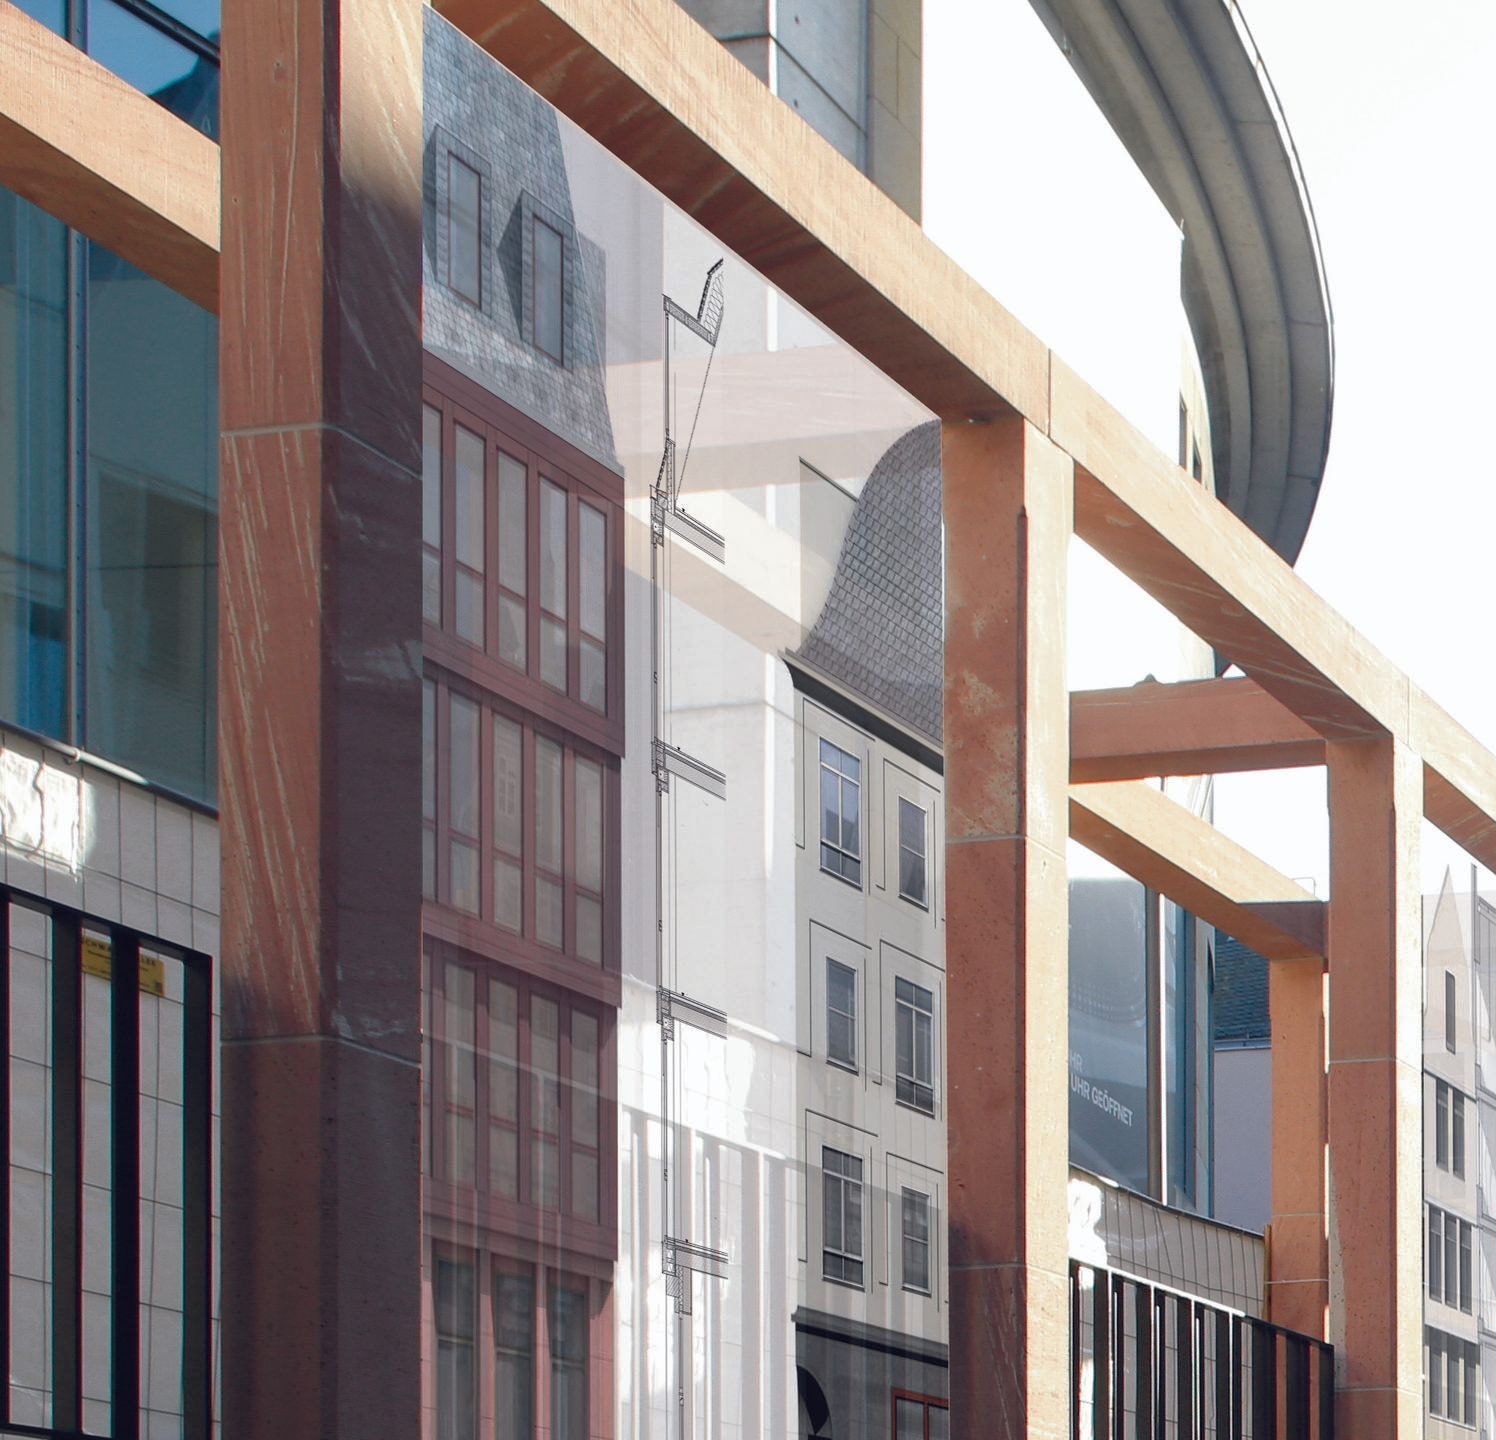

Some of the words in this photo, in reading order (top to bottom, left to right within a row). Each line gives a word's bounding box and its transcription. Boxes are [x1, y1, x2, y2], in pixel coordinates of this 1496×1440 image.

[1070, 1050, 1083, 1073] HR
[1070, 1073, 1090, 1100] UHR
[1092, 1086, 1134, 1128] GEÖFFNET
